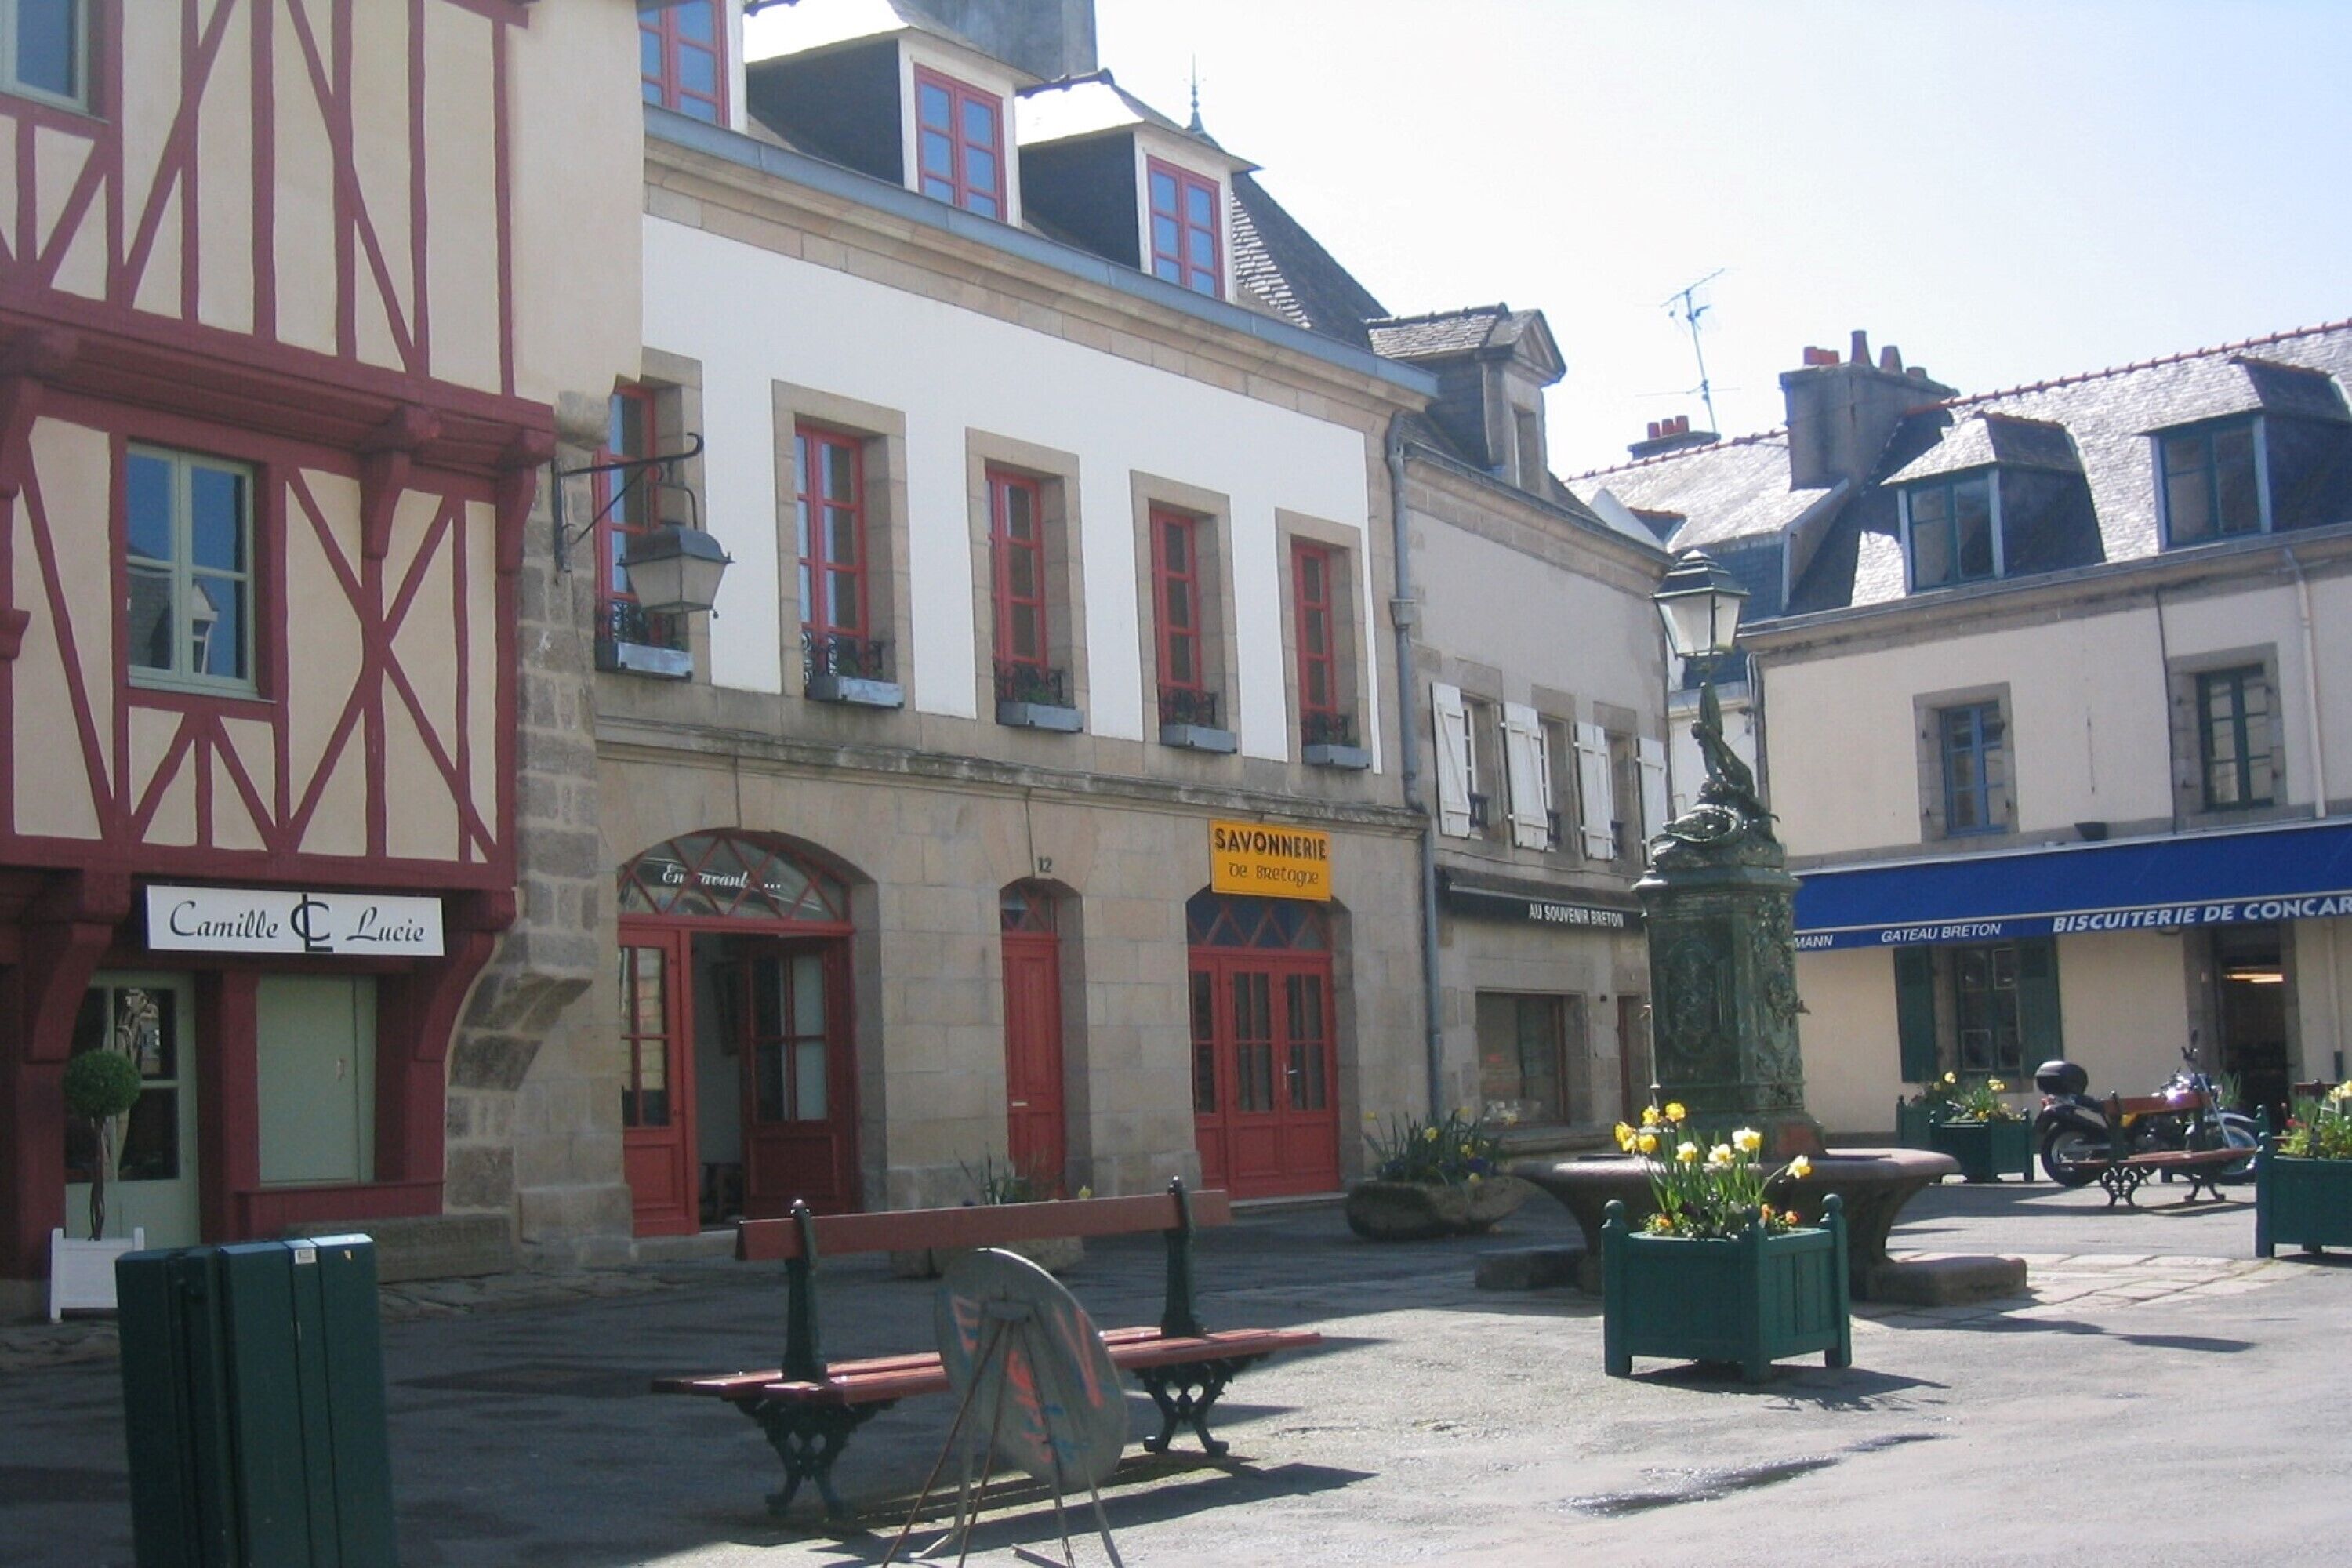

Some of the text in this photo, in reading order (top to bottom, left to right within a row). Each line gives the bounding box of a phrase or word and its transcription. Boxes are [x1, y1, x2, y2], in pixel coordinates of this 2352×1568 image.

[1215, 828, 1327, 861] SAVONNERIE
[662, 863, 684, 884] En
[1037, 856, 1052, 873] 12
[169, 900, 278, 939] Camille
[345, 906, 425, 942] Lucie
[1529, 903, 1624, 928] AU SOUVENIR BRETON
[2052, 895, 2352, 933] BISCUITERIE DE CONCAR
[1881, 923, 2002, 943] GATEAU BRETON
